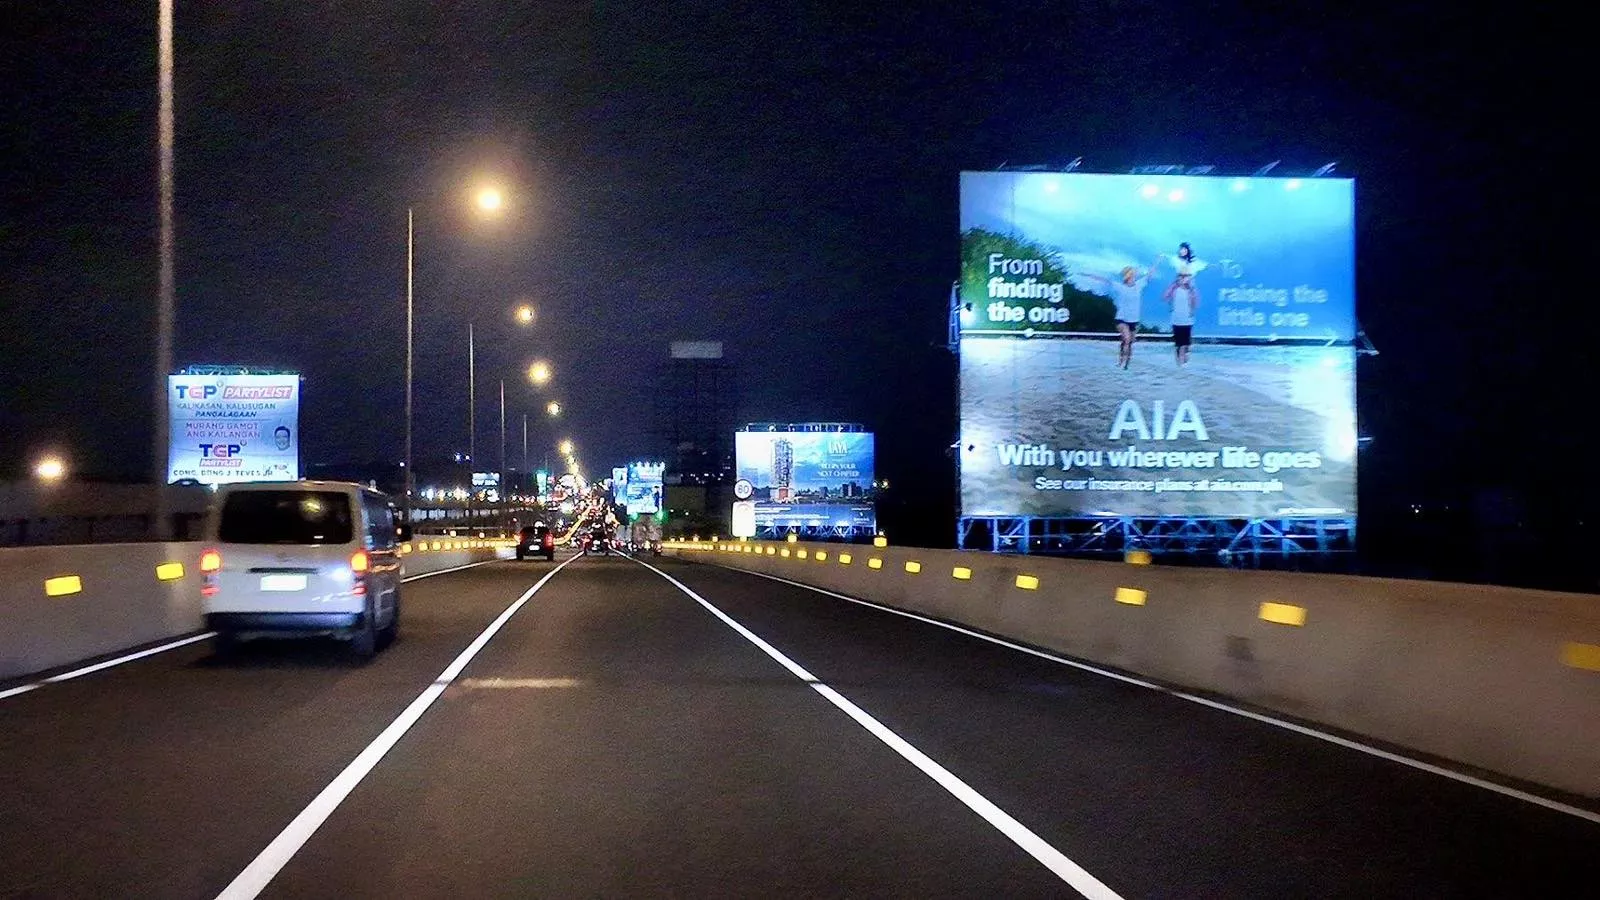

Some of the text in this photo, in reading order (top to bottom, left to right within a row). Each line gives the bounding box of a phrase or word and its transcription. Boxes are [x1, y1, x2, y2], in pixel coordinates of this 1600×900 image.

[988, 254, 1043, 276] From
[1220, 259, 1242, 279] To
[988, 278, 1064, 303] finding
[1218, 284, 1328, 305] raising the
[988, 301, 1070, 324] the one
[1218, 305, 1309, 327] little one
[176, 386, 291, 399] TGP PARTYLIST
[226, 402, 276, 410] KALUSUGAN
[187, 422, 259, 430] MURANG GAMOT
[1109, 399, 1209, 441] AIA
[208, 431, 261, 439] KAILANGAN
[199, 444, 241, 457] TGP
[998, 444, 1322, 473] With you wherever life goes
[1035, 477, 1062, 490] See
[1063, 480, 1088, 491] our
[1088, 477, 1155, 491] insurance
